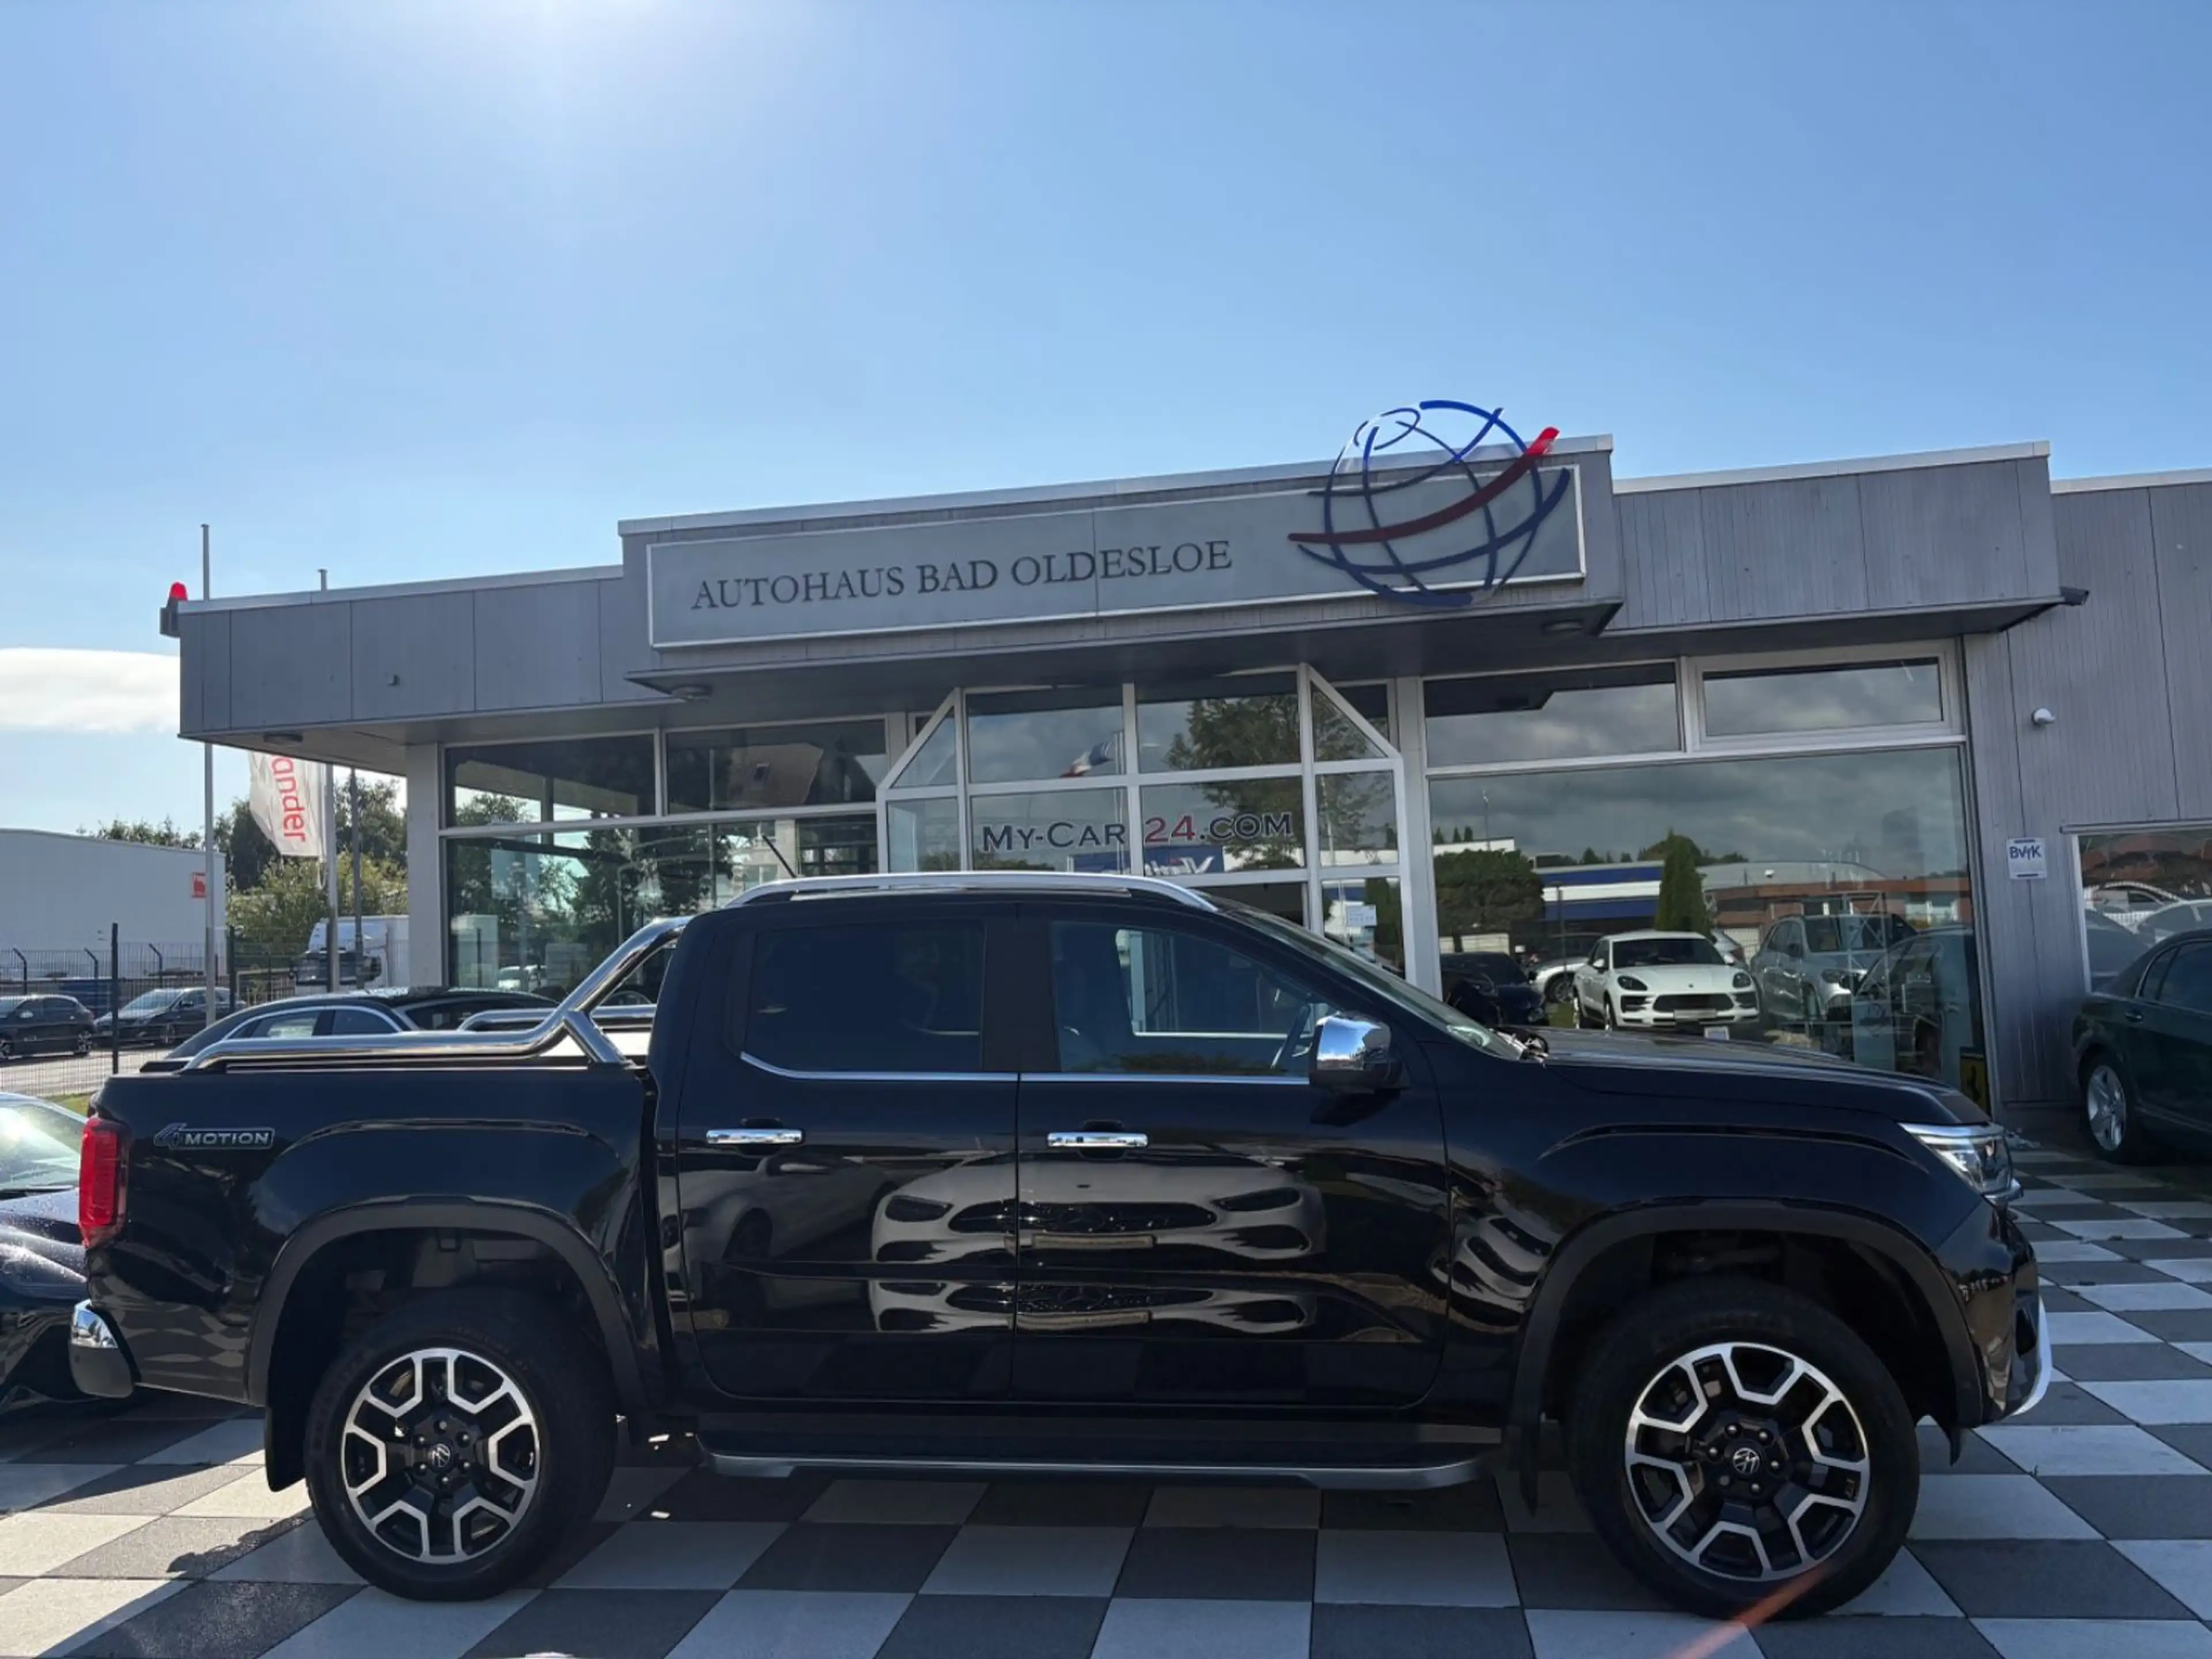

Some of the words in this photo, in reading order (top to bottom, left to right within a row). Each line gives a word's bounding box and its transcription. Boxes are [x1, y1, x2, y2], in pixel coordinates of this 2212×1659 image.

[691, 566, 905, 609] AUTOHAUS
[915, 559, 998, 594] BAD
[1010, 540, 1233, 586] OLDESLOE
